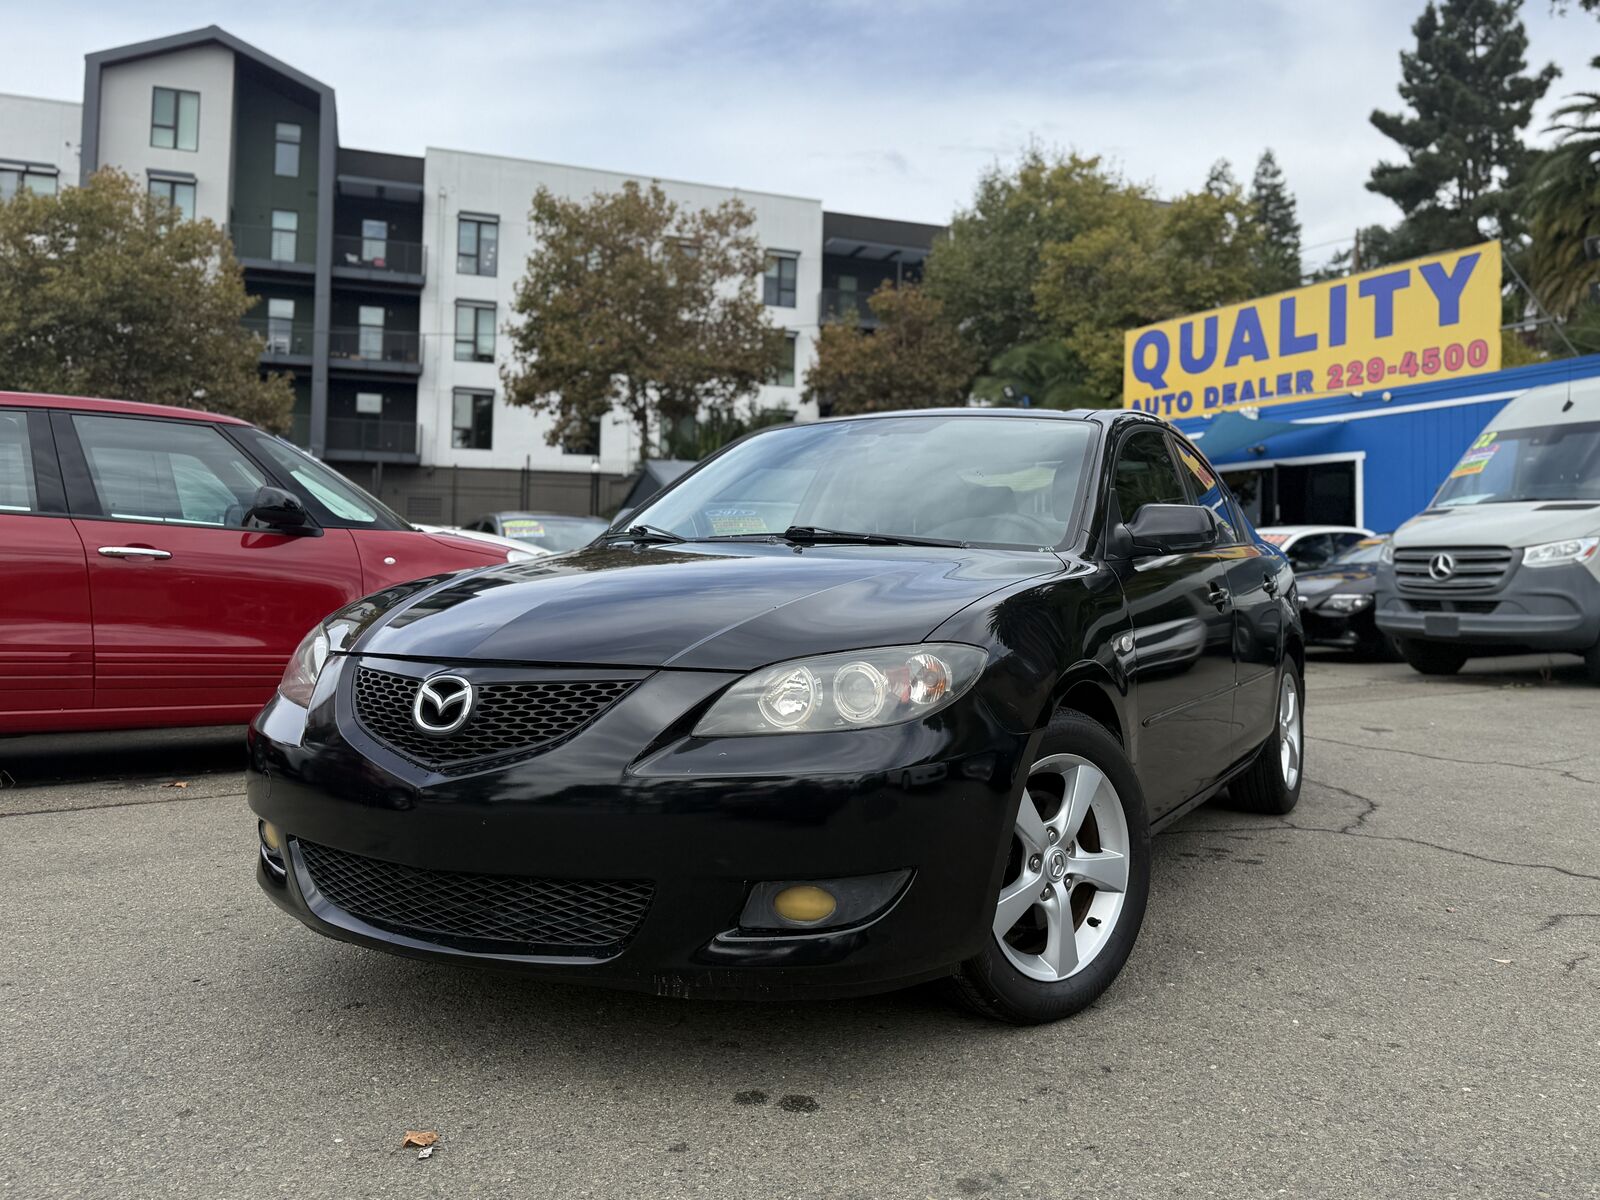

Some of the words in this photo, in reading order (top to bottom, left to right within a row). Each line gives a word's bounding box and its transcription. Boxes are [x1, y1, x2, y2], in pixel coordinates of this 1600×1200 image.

[1132, 253, 1482, 389] QUALITY
[1204, 370, 1314, 409] DEALER
[1327, 339, 1489, 389] 229-4500
